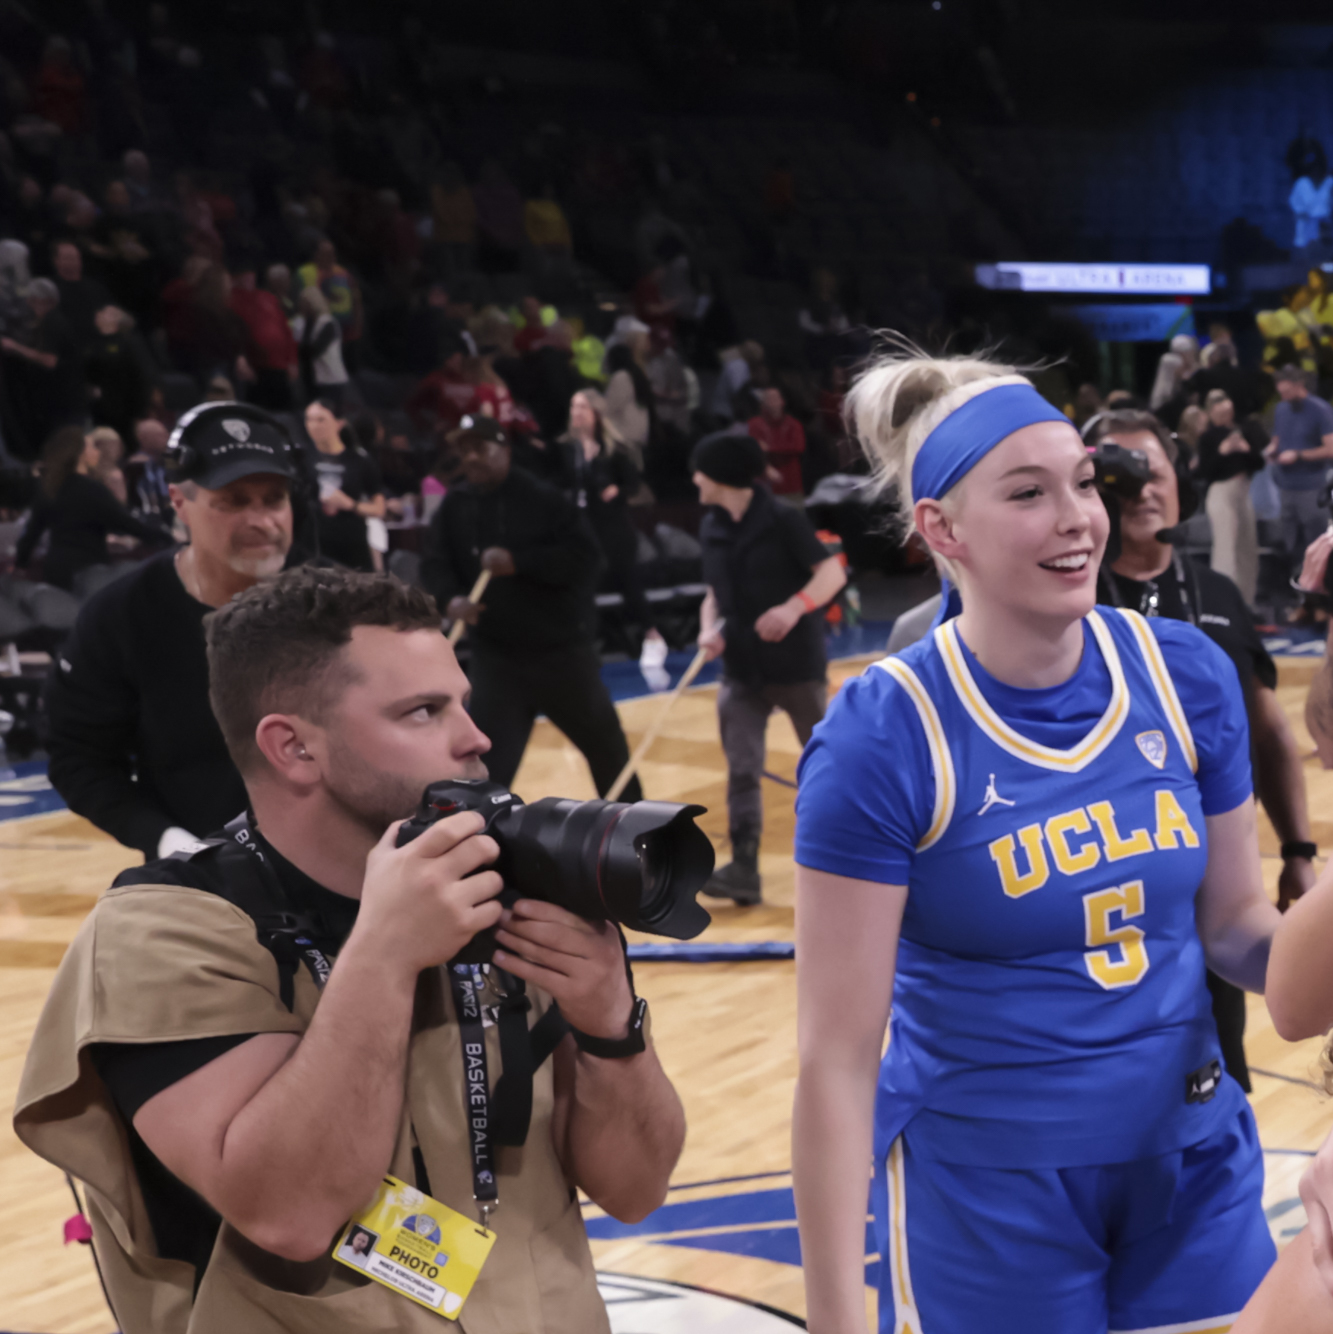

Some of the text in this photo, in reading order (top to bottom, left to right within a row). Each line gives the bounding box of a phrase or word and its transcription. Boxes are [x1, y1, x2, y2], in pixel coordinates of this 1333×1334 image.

[989, 790, 1200, 899] UCLA
[1082, 881, 1150, 990] 5
[465, 1043, 489, 1165] BASKETBALL
[389, 1246, 438, 1279] PHOTO
